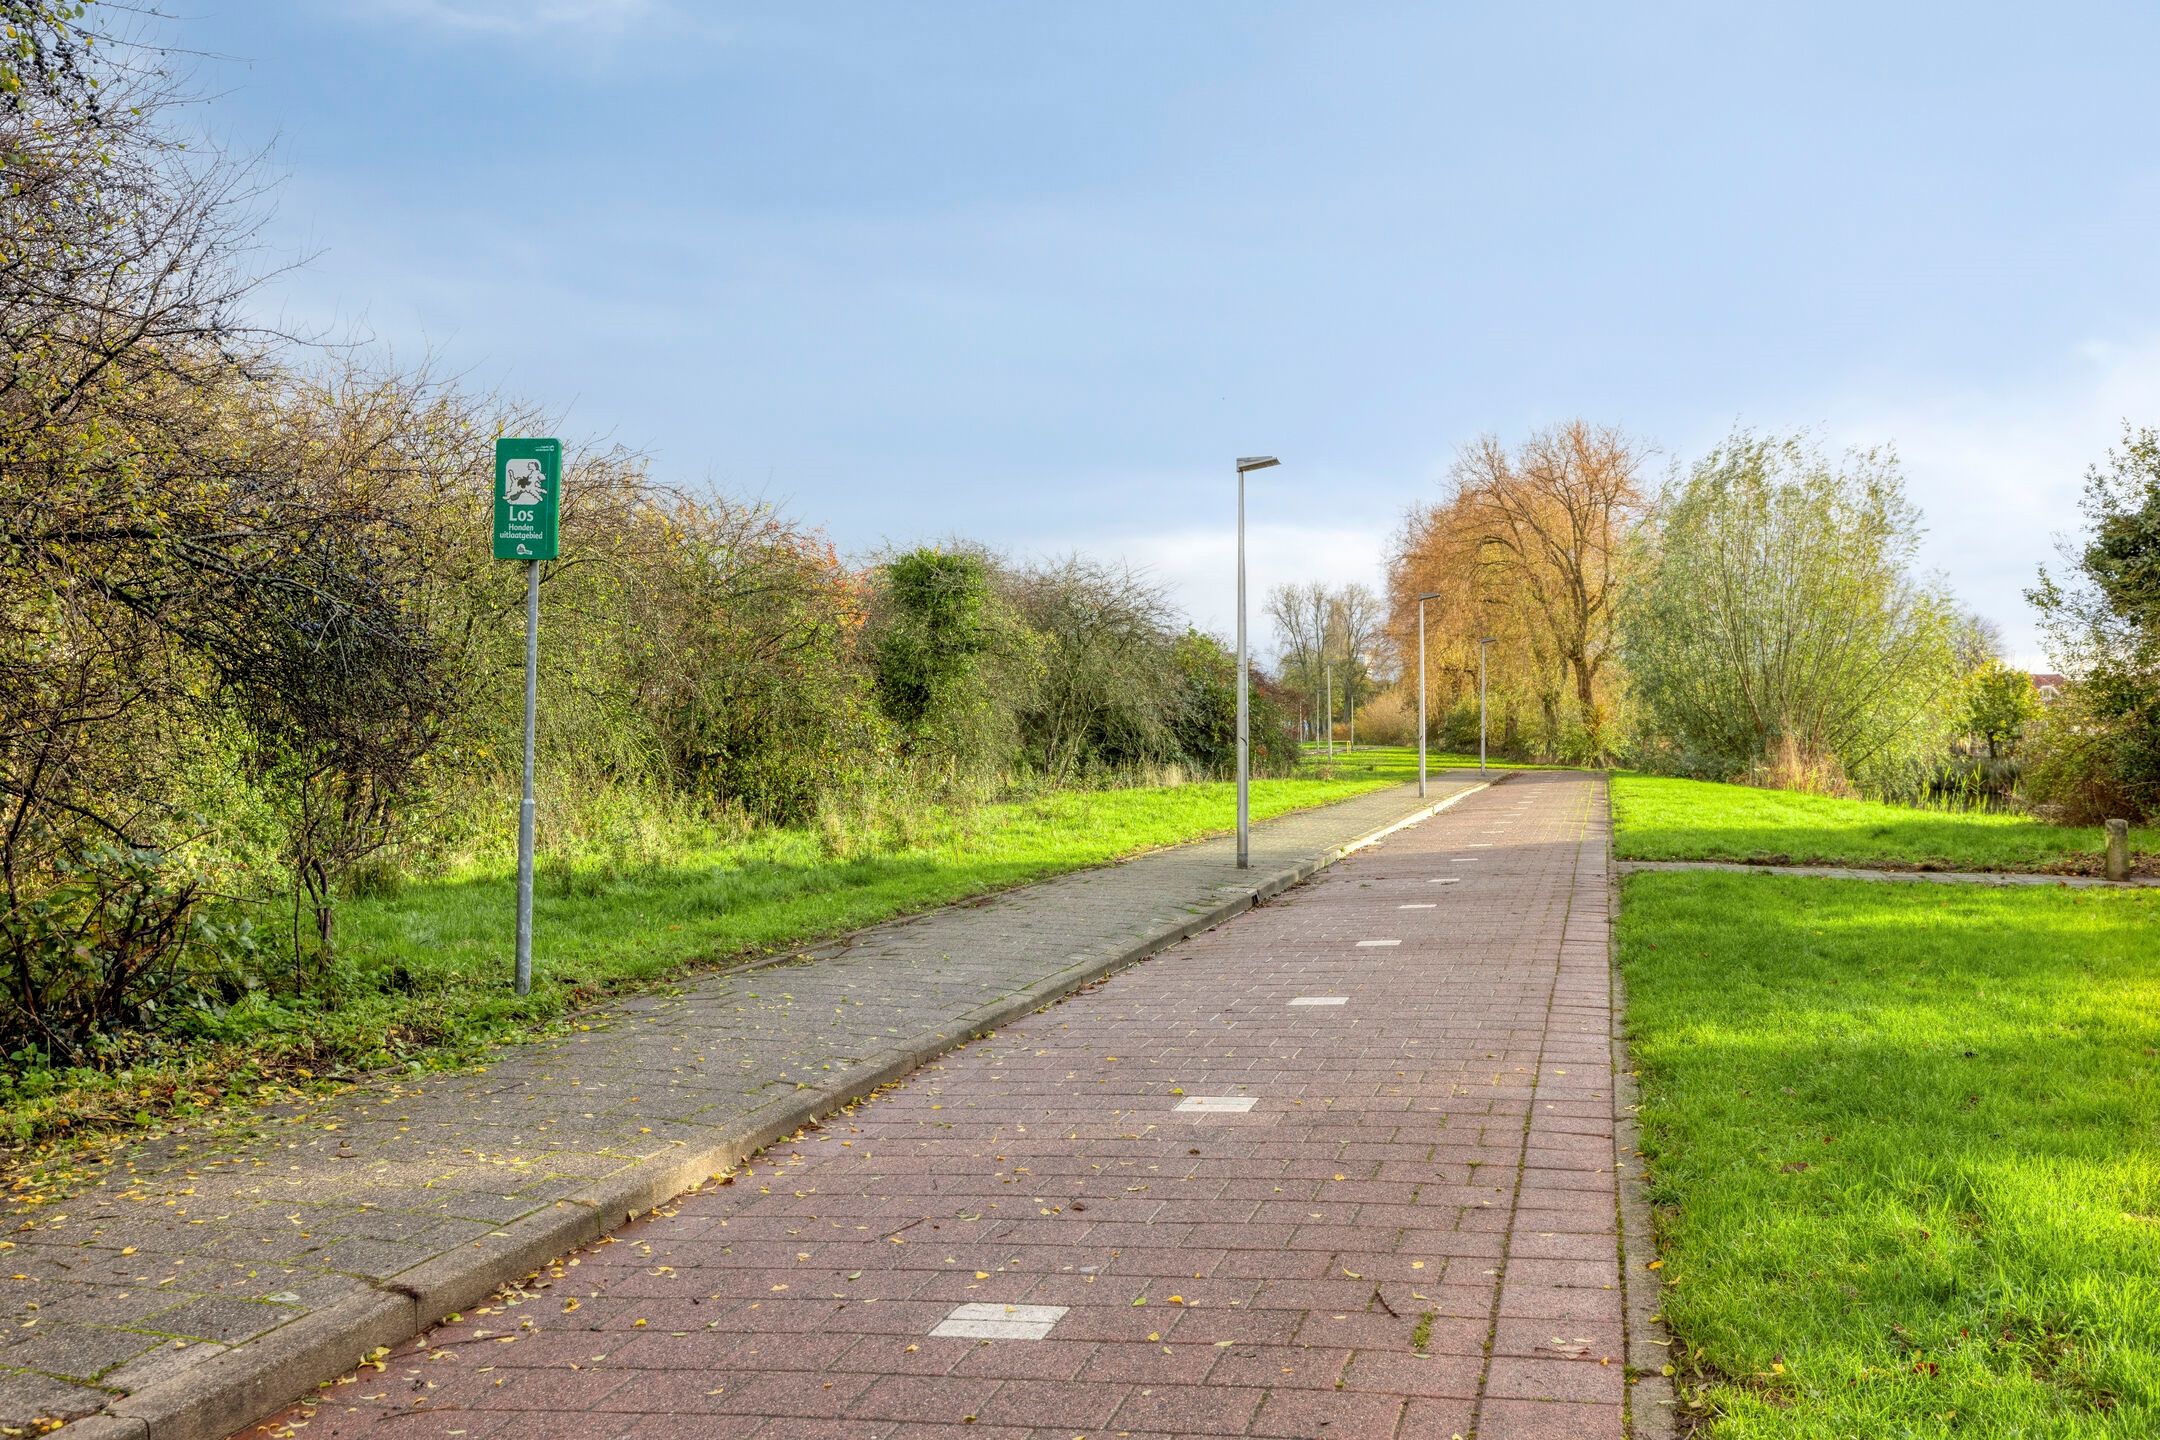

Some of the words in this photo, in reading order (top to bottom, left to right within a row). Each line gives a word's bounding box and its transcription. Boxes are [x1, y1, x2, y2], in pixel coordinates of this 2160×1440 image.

[509, 505, 534, 521] Los
[508, 523, 534, 531] Honden
[499, 531, 543, 540] uitlaatgebied
